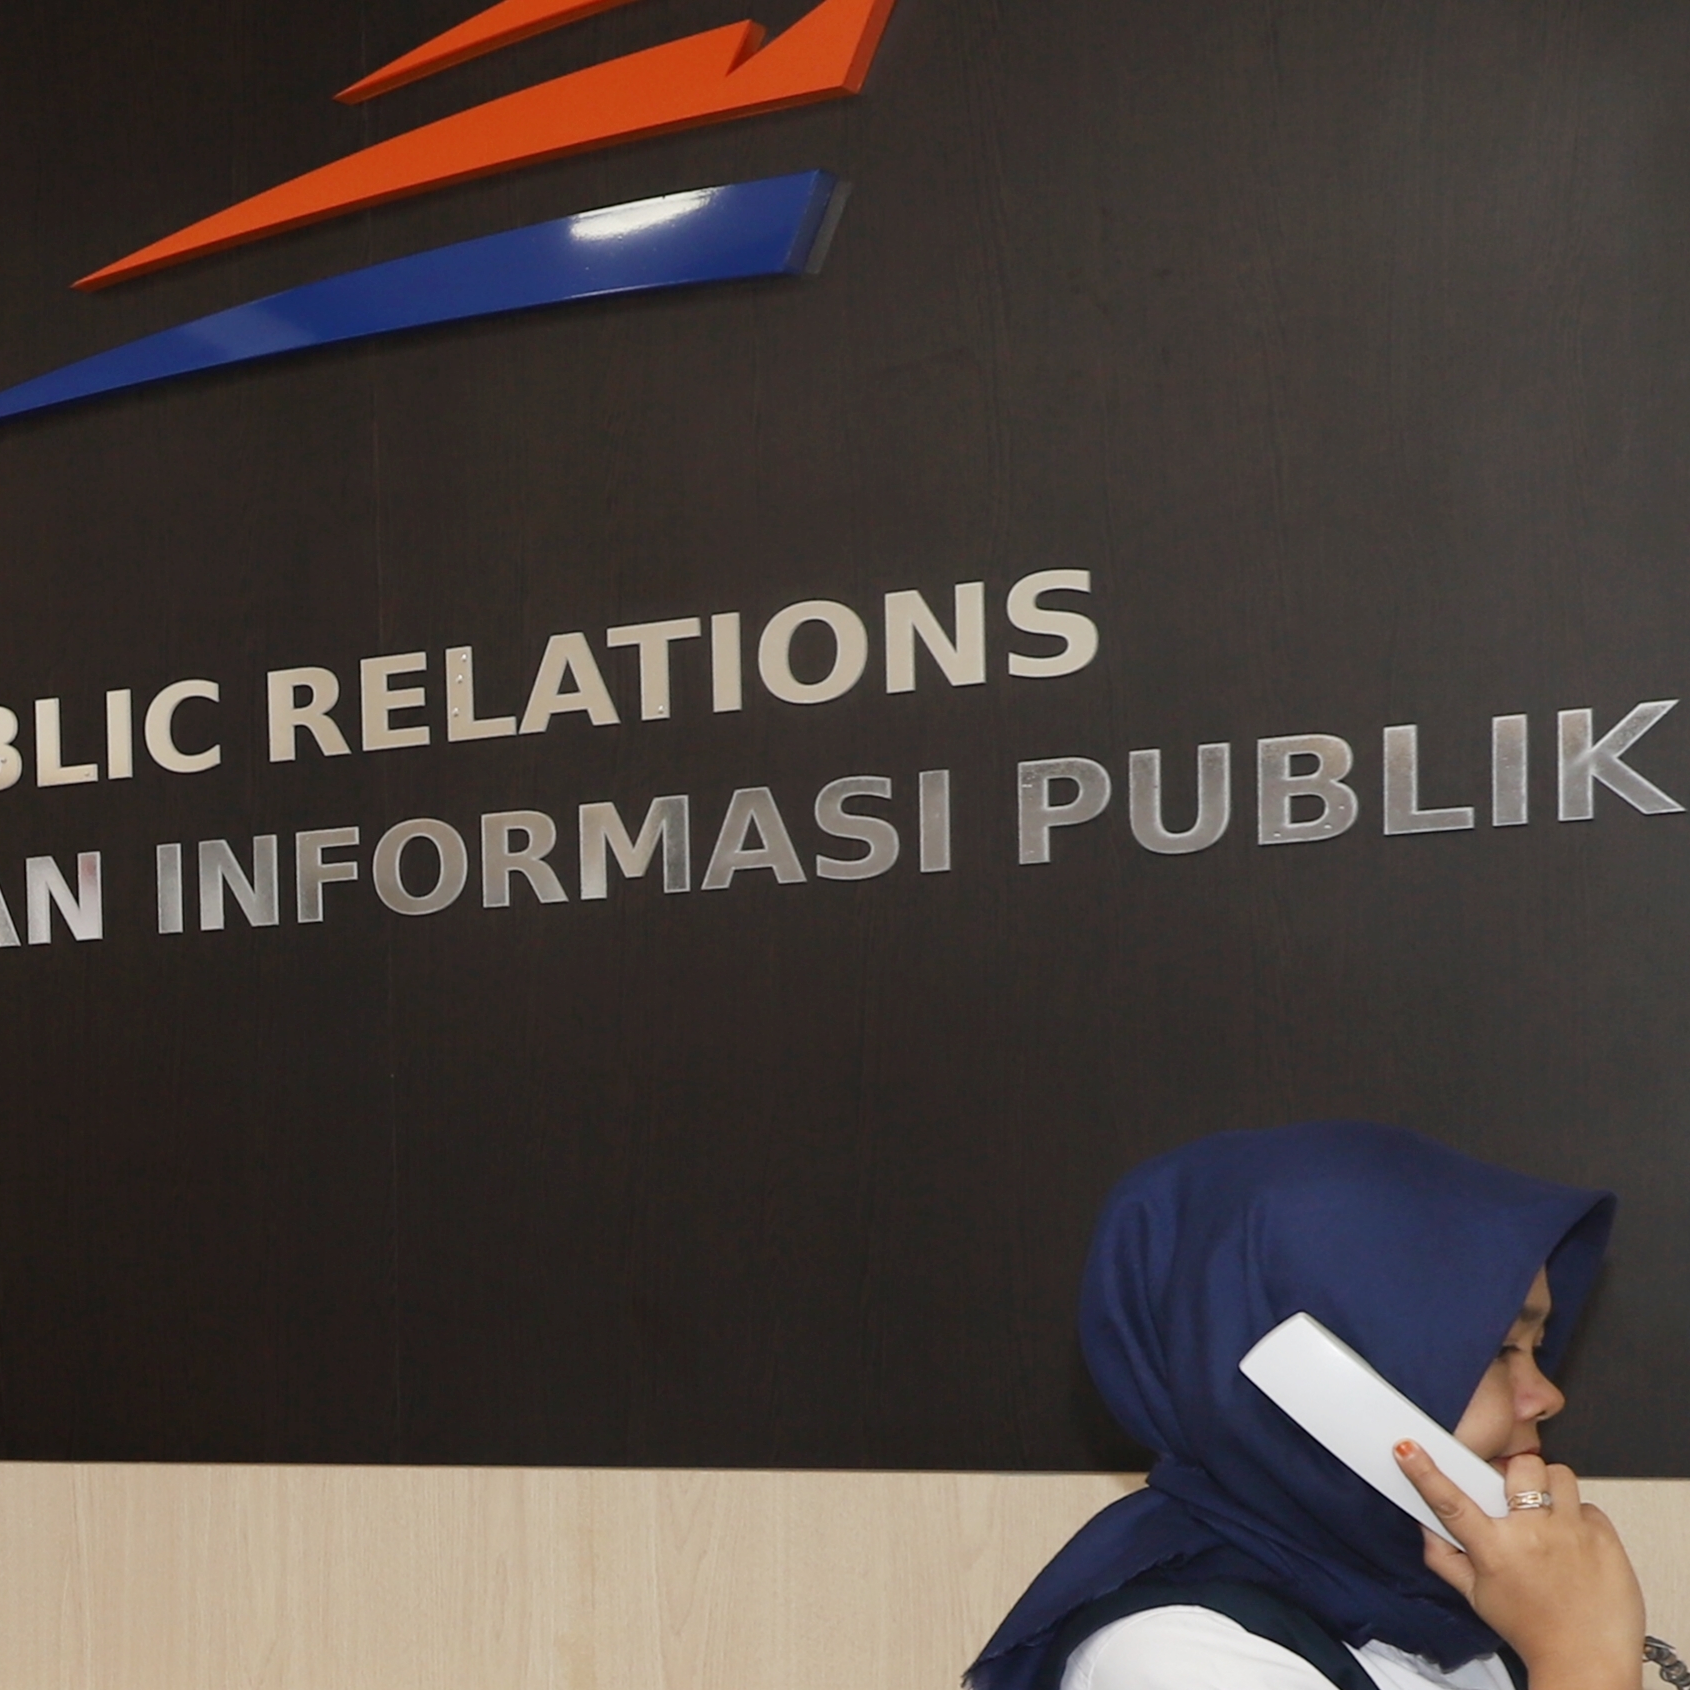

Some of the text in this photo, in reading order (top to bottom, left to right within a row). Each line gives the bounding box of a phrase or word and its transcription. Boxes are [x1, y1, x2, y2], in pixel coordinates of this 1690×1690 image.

[267, 568, 1099, 762] RELATIONS
[156, 769, 952, 935] INFORMASI
[1017, 700, 1684, 867] PUBLIK
